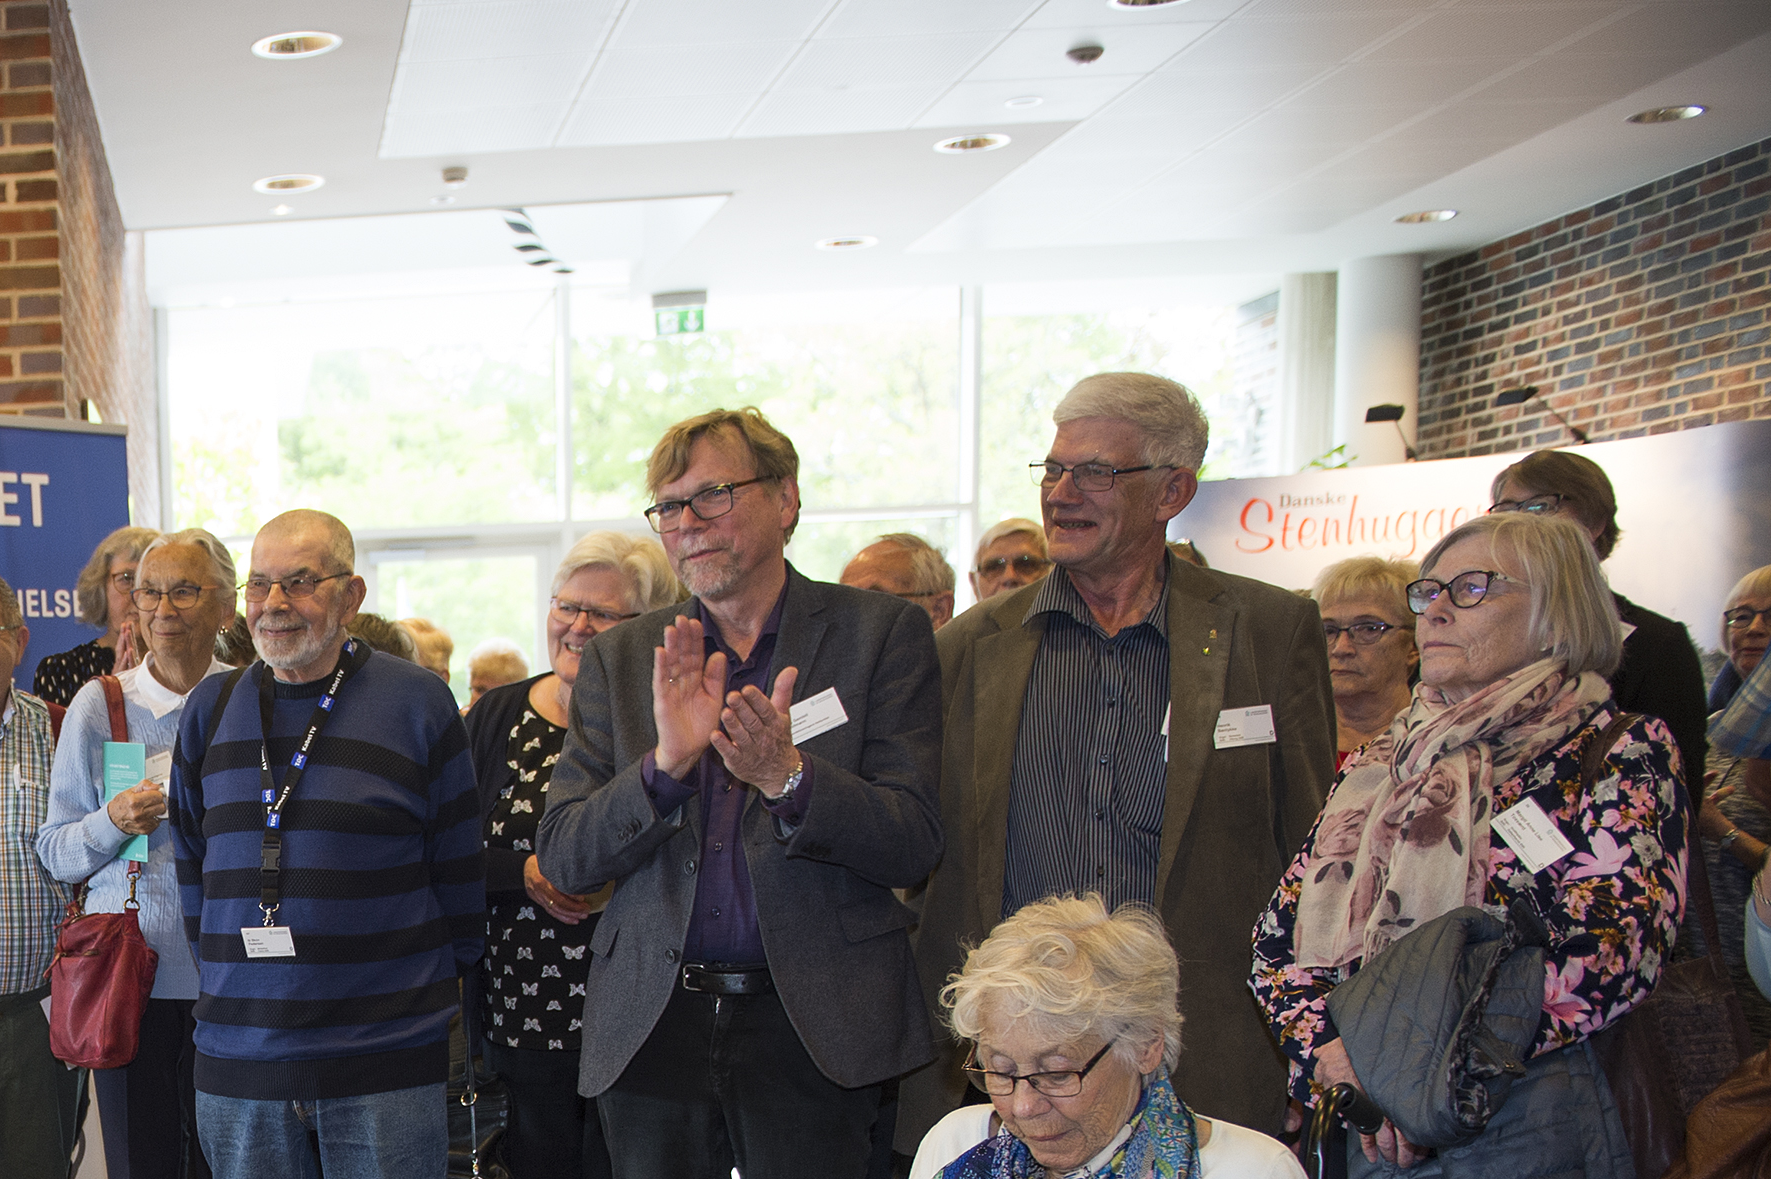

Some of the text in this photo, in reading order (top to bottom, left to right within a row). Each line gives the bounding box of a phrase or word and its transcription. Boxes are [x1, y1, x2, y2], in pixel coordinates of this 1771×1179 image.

[1279, 492, 1347, 509] Danske
[1235, 494, 1489, 560] Stenhugge
[322, 668, 345, 709] TDC Kabel TV
[294, 725, 317, 767] TDC Kabel TV
[270, 813, 278, 827] TDC
